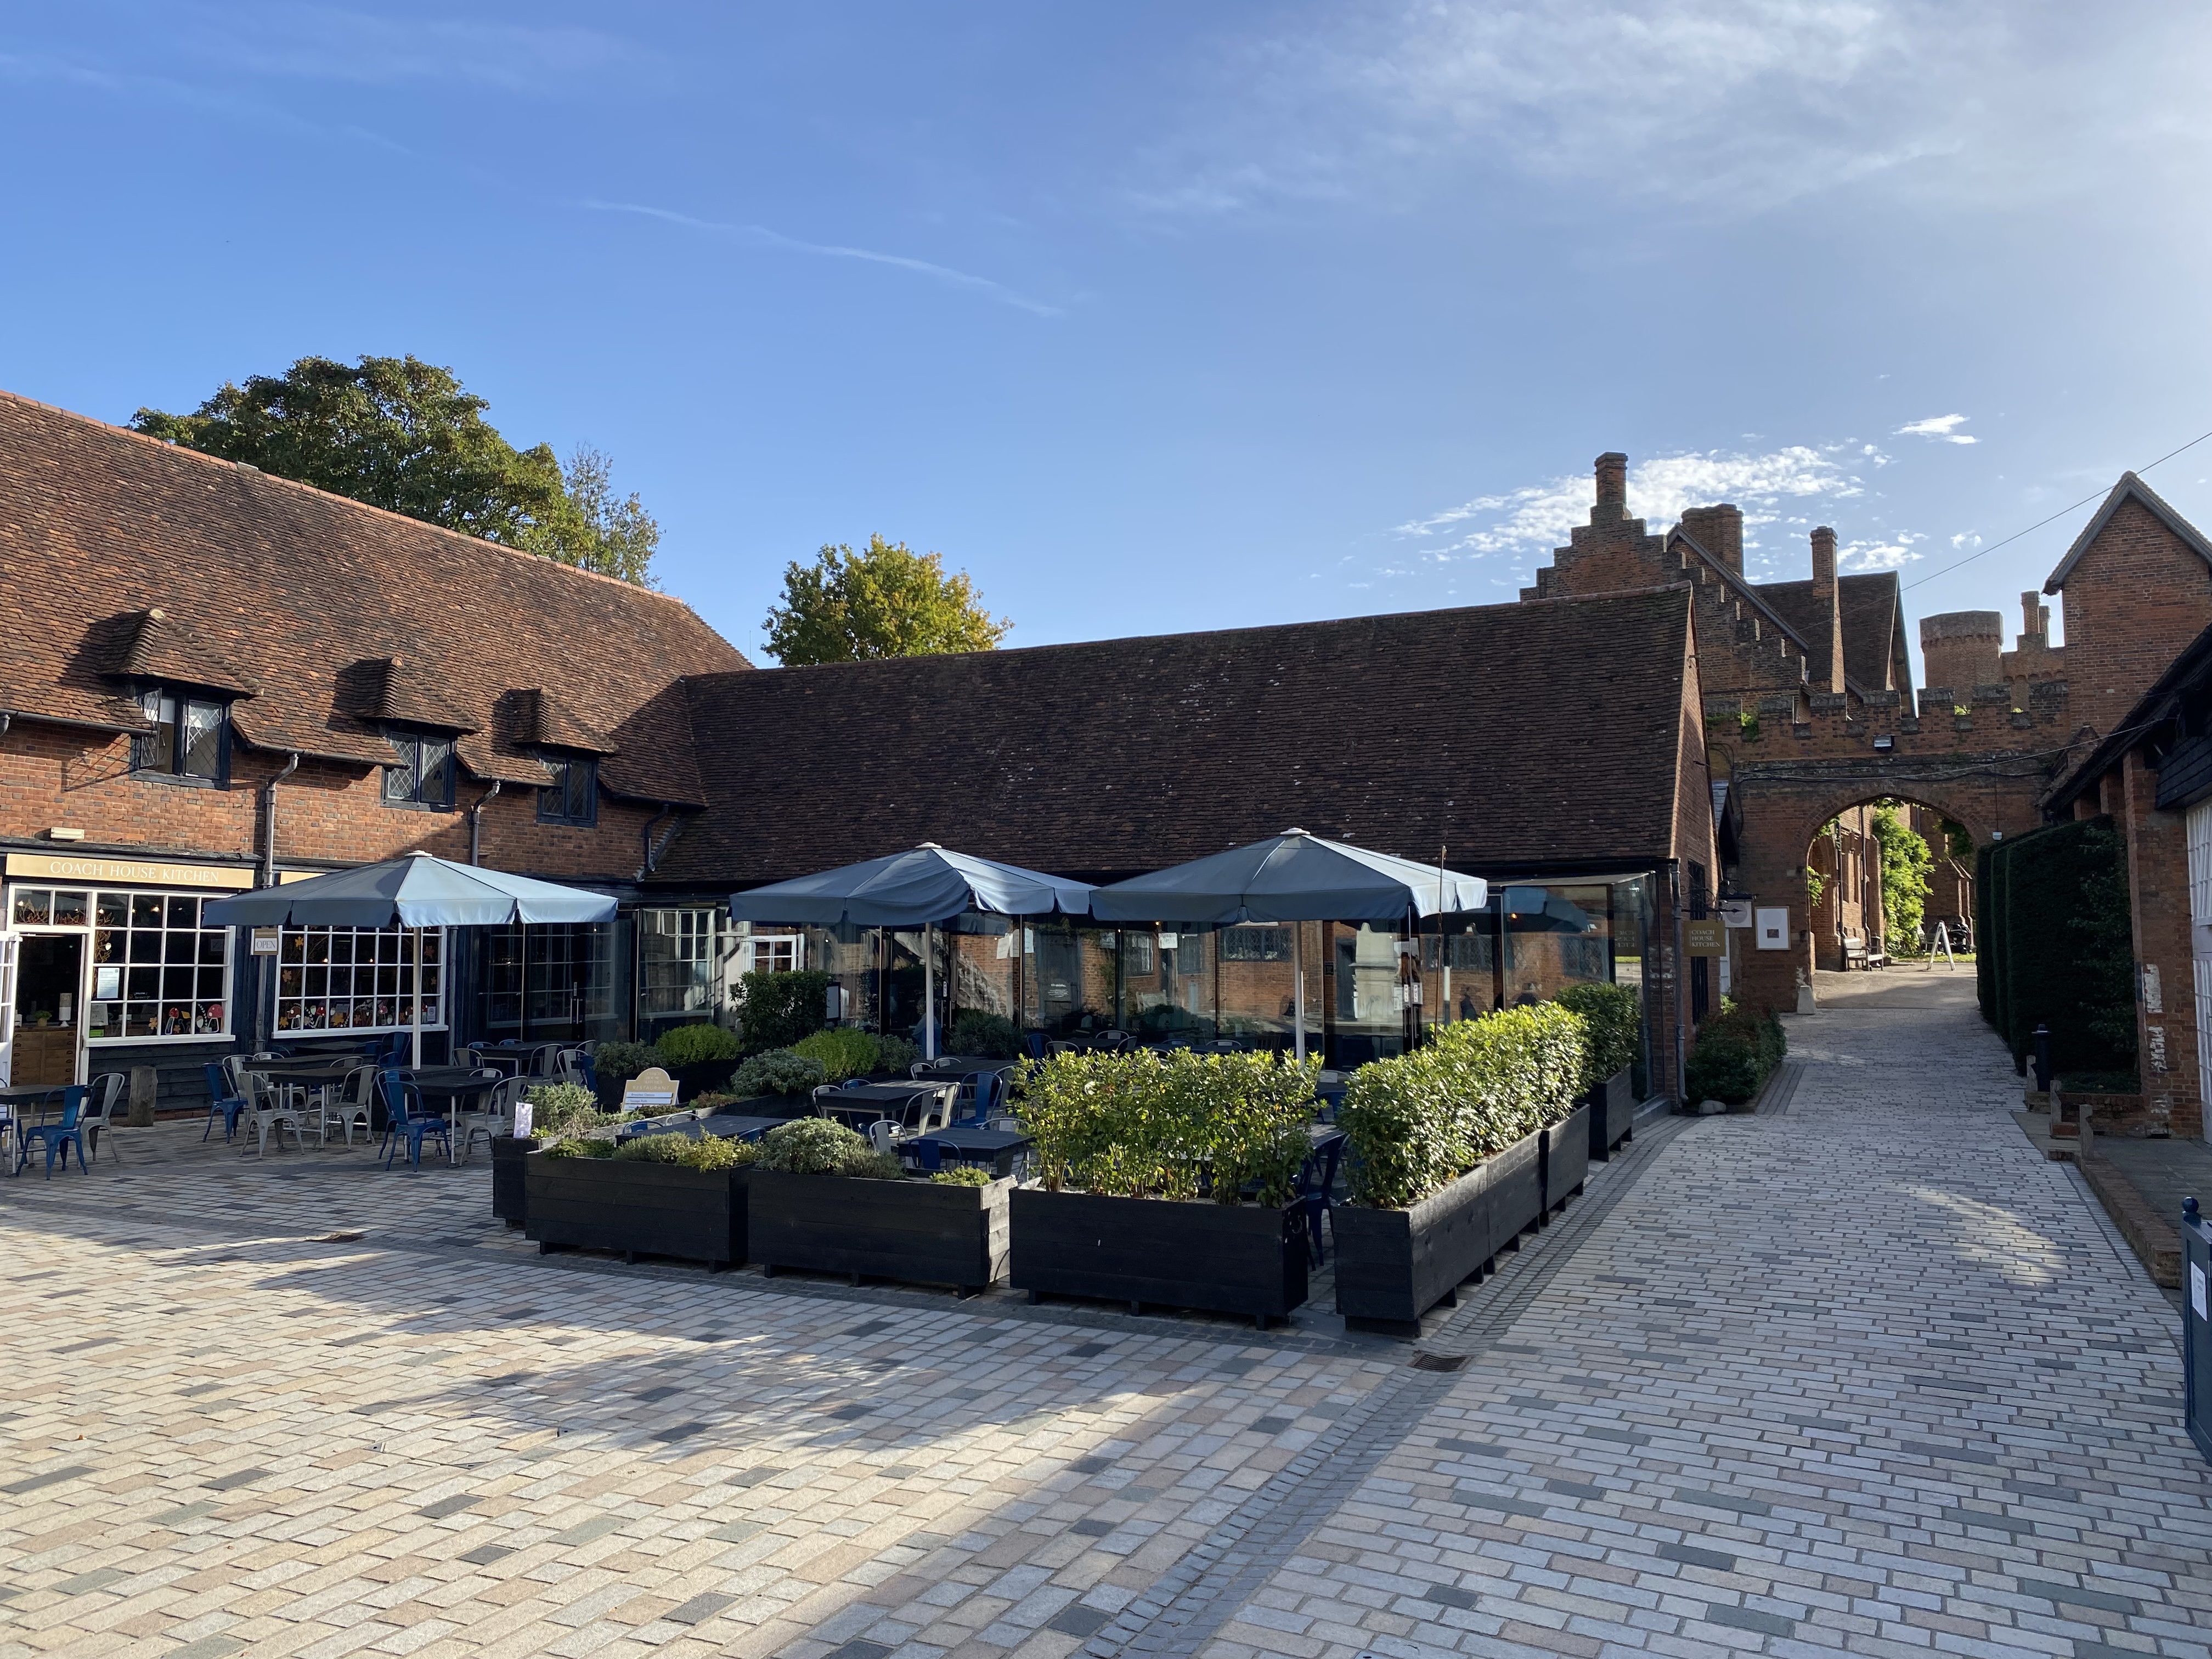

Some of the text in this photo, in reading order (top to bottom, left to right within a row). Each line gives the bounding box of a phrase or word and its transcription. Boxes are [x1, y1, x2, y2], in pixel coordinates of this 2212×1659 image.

[50, 861, 219, 882] COACH HOUSE KITCHEN
[256, 940, 276, 949] OPEN
